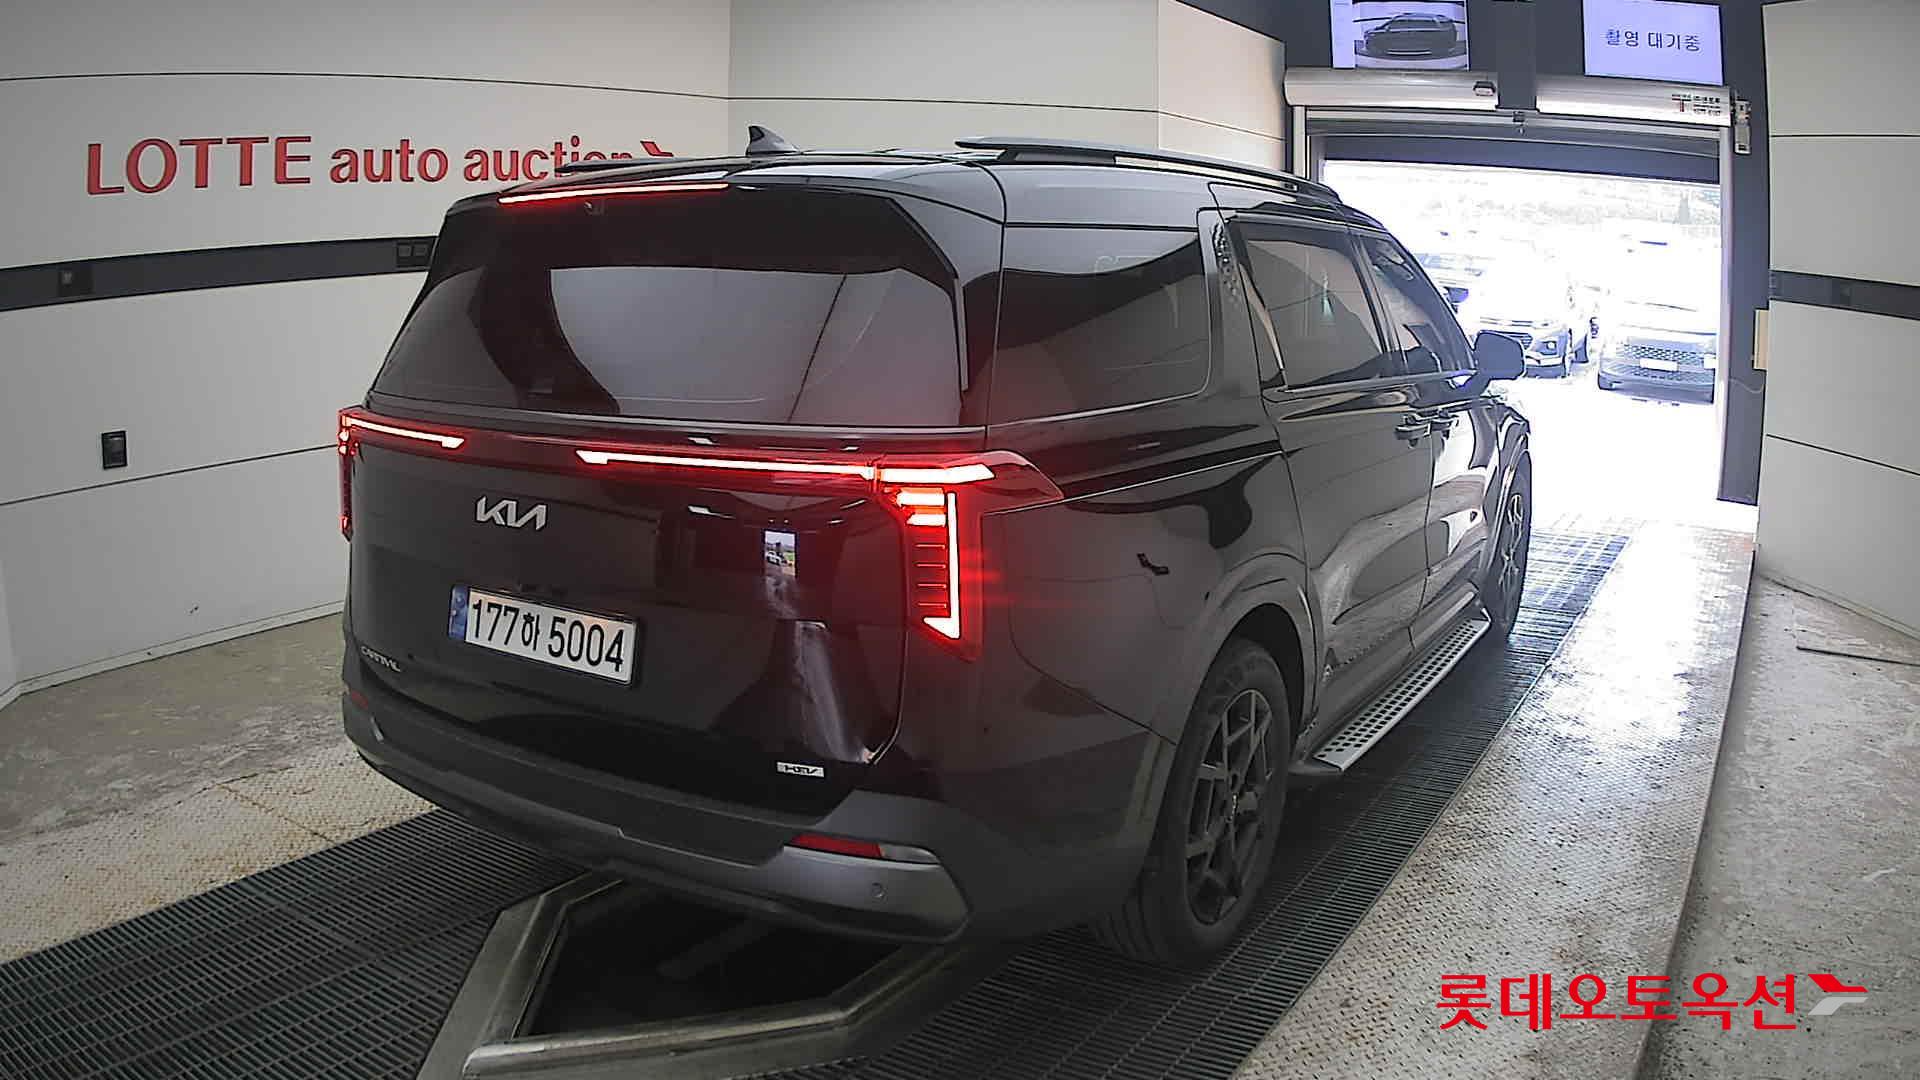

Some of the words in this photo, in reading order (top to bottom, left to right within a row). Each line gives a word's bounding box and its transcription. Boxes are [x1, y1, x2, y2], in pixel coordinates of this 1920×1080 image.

[86, 136, 311, 195] LOTTE
[329, 139, 449, 184] auto
[463, 135, 633, 181] aucti
[475, 496, 547, 530] KIA
[472, 599, 540, 651] 177하
[548, 616, 624, 673] 5004
